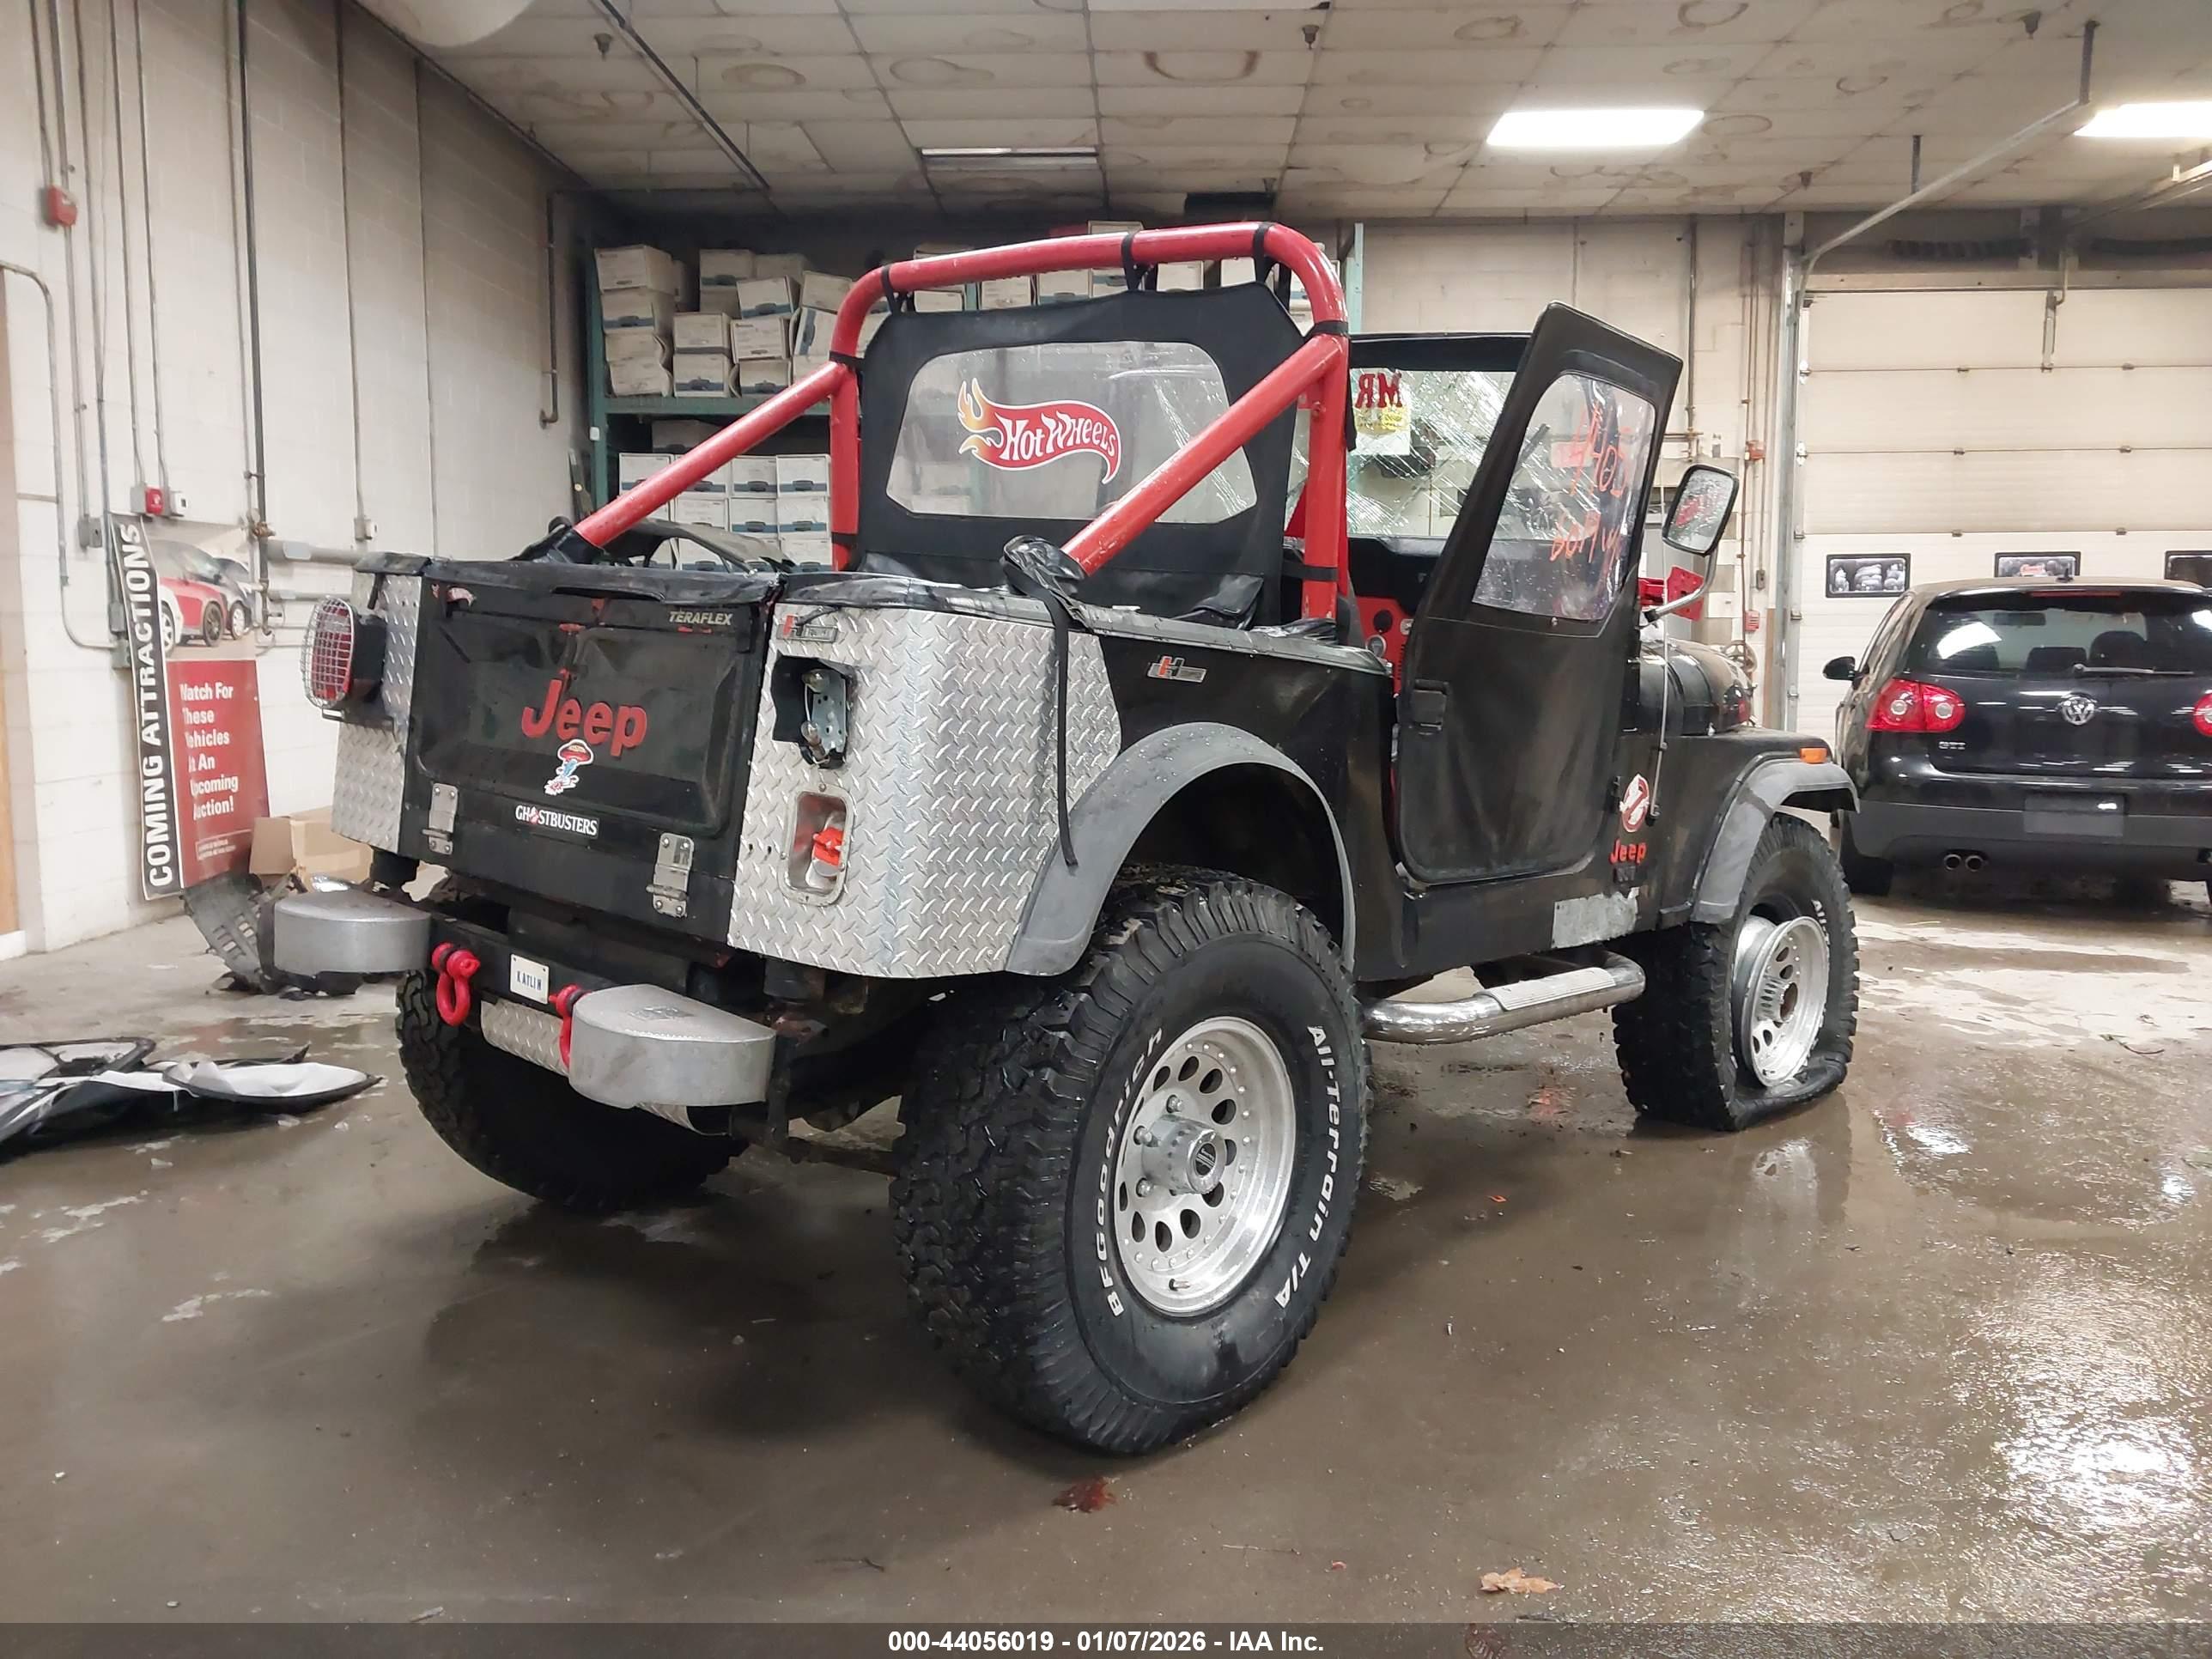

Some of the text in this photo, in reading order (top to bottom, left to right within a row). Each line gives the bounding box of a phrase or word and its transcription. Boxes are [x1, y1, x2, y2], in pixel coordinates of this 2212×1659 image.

[994, 412, 1045, 461] Hot
[669, 611, 732, 626] TERAFLEX
[119, 523, 173, 887] COMING ATTRACTIONS
[215, 682, 234, 700] For
[521, 679, 647, 757] Jeep
[198, 753, 216, 771] An
[1609, 838, 1647, 864] Jeep
[1095, 1028, 1163, 1316] BFGoodrich
[1274, 1026, 1341, 1309] All-Terrain T/A
